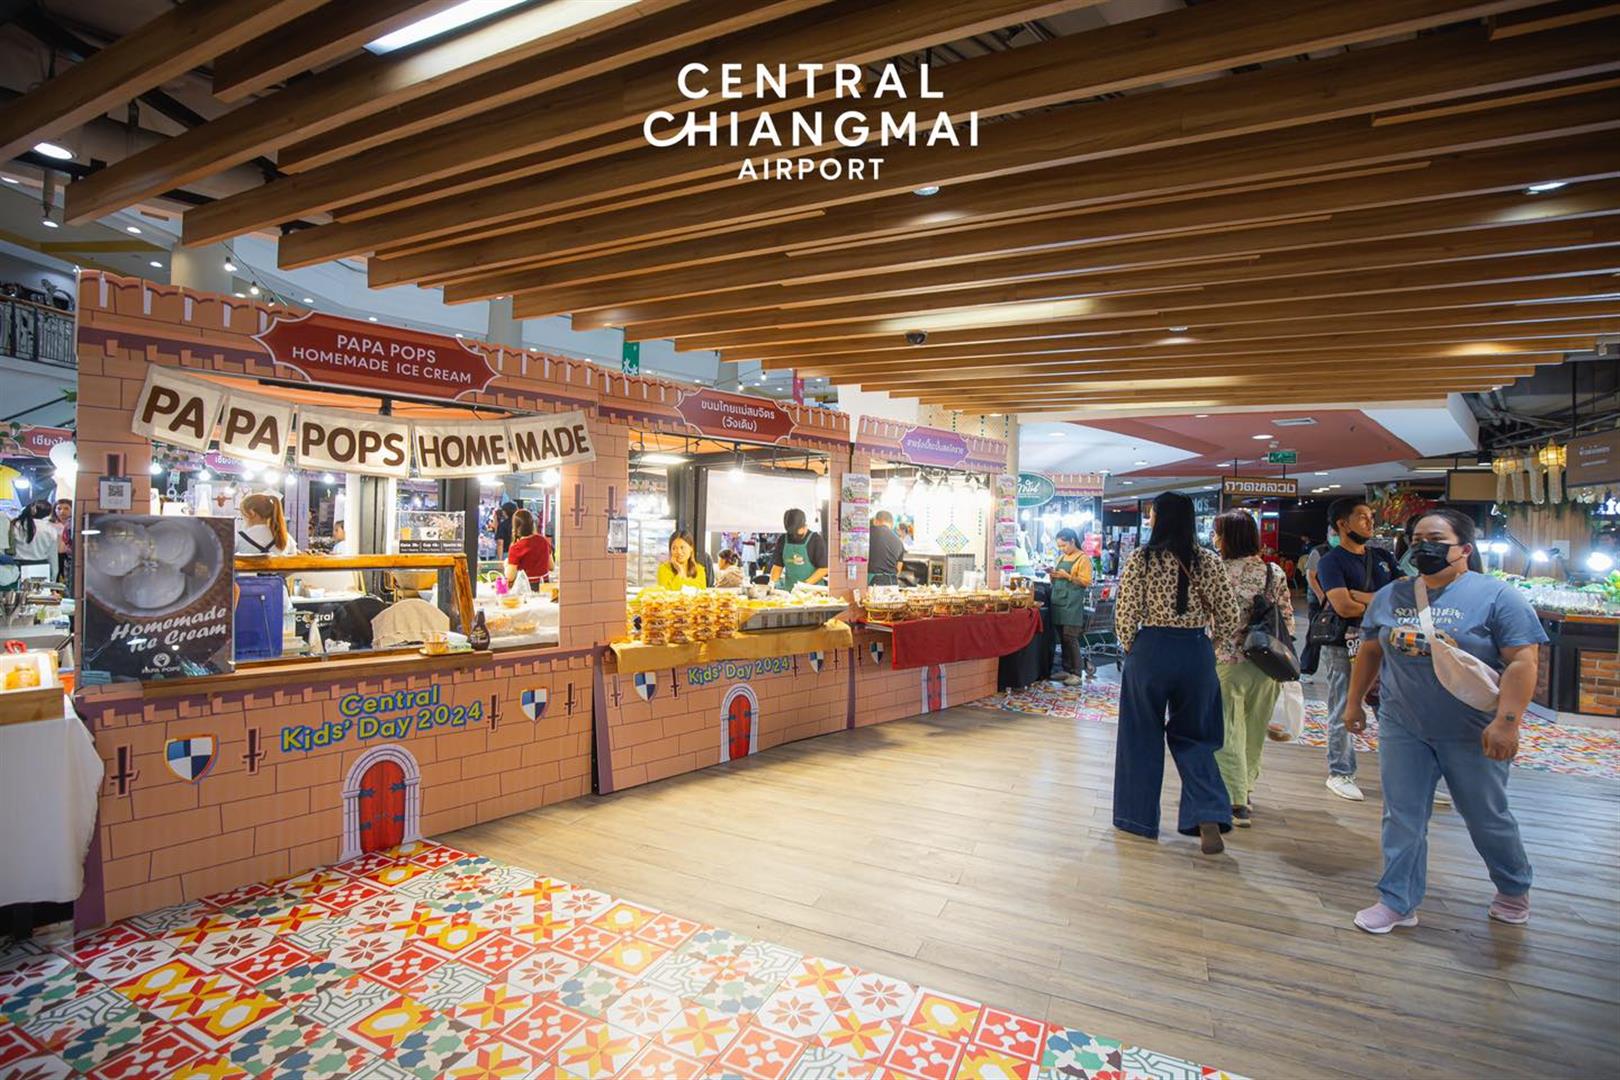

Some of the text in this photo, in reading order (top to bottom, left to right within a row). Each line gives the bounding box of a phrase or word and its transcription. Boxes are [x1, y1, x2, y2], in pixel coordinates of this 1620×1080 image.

[291, 346, 472, 384] HOMEMADE ICE CREAM
[336, 334, 437, 364] PAPA POPS
[141, 384, 590, 468] PA PA POPS HOME MADE
[701, 399, 775, 420] ขนมไทยแม่สมจิตร
[110, 605, 227, 641] Homemade
[128, 623, 227, 653] Ice Cream
[687, 656, 790, 685] Kids' Day 2024
[339, 684, 441, 717] Central
[281, 701, 484, 753] Kids' Day 2024
